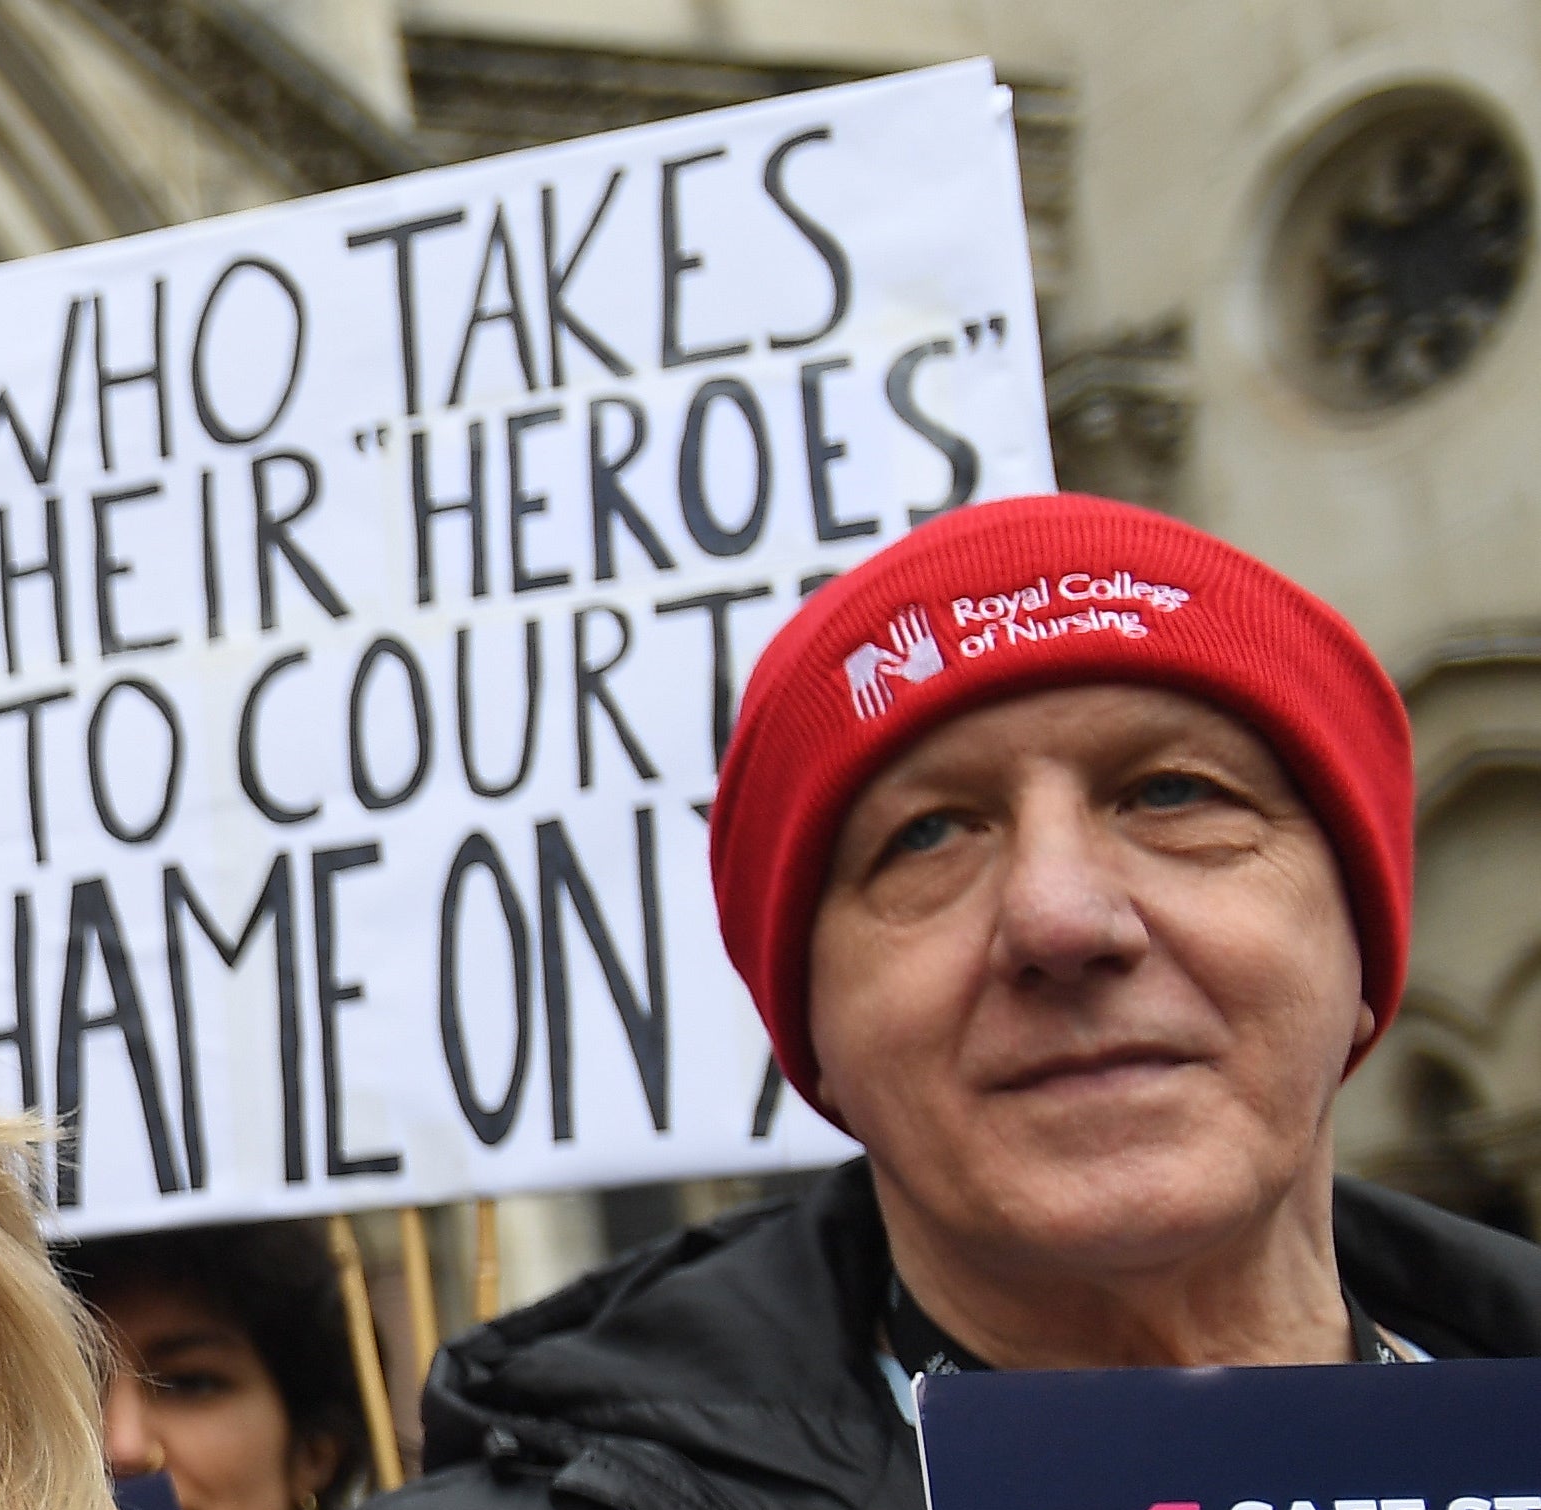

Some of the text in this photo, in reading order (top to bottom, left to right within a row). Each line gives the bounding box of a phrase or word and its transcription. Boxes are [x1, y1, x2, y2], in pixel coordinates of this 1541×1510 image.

[346, 124, 853, 418] TAKES
[951, 570, 1191, 629] Royal College
[958, 604, 1150, 660] of Nursing
[438, 804, 669, 1146] ON
